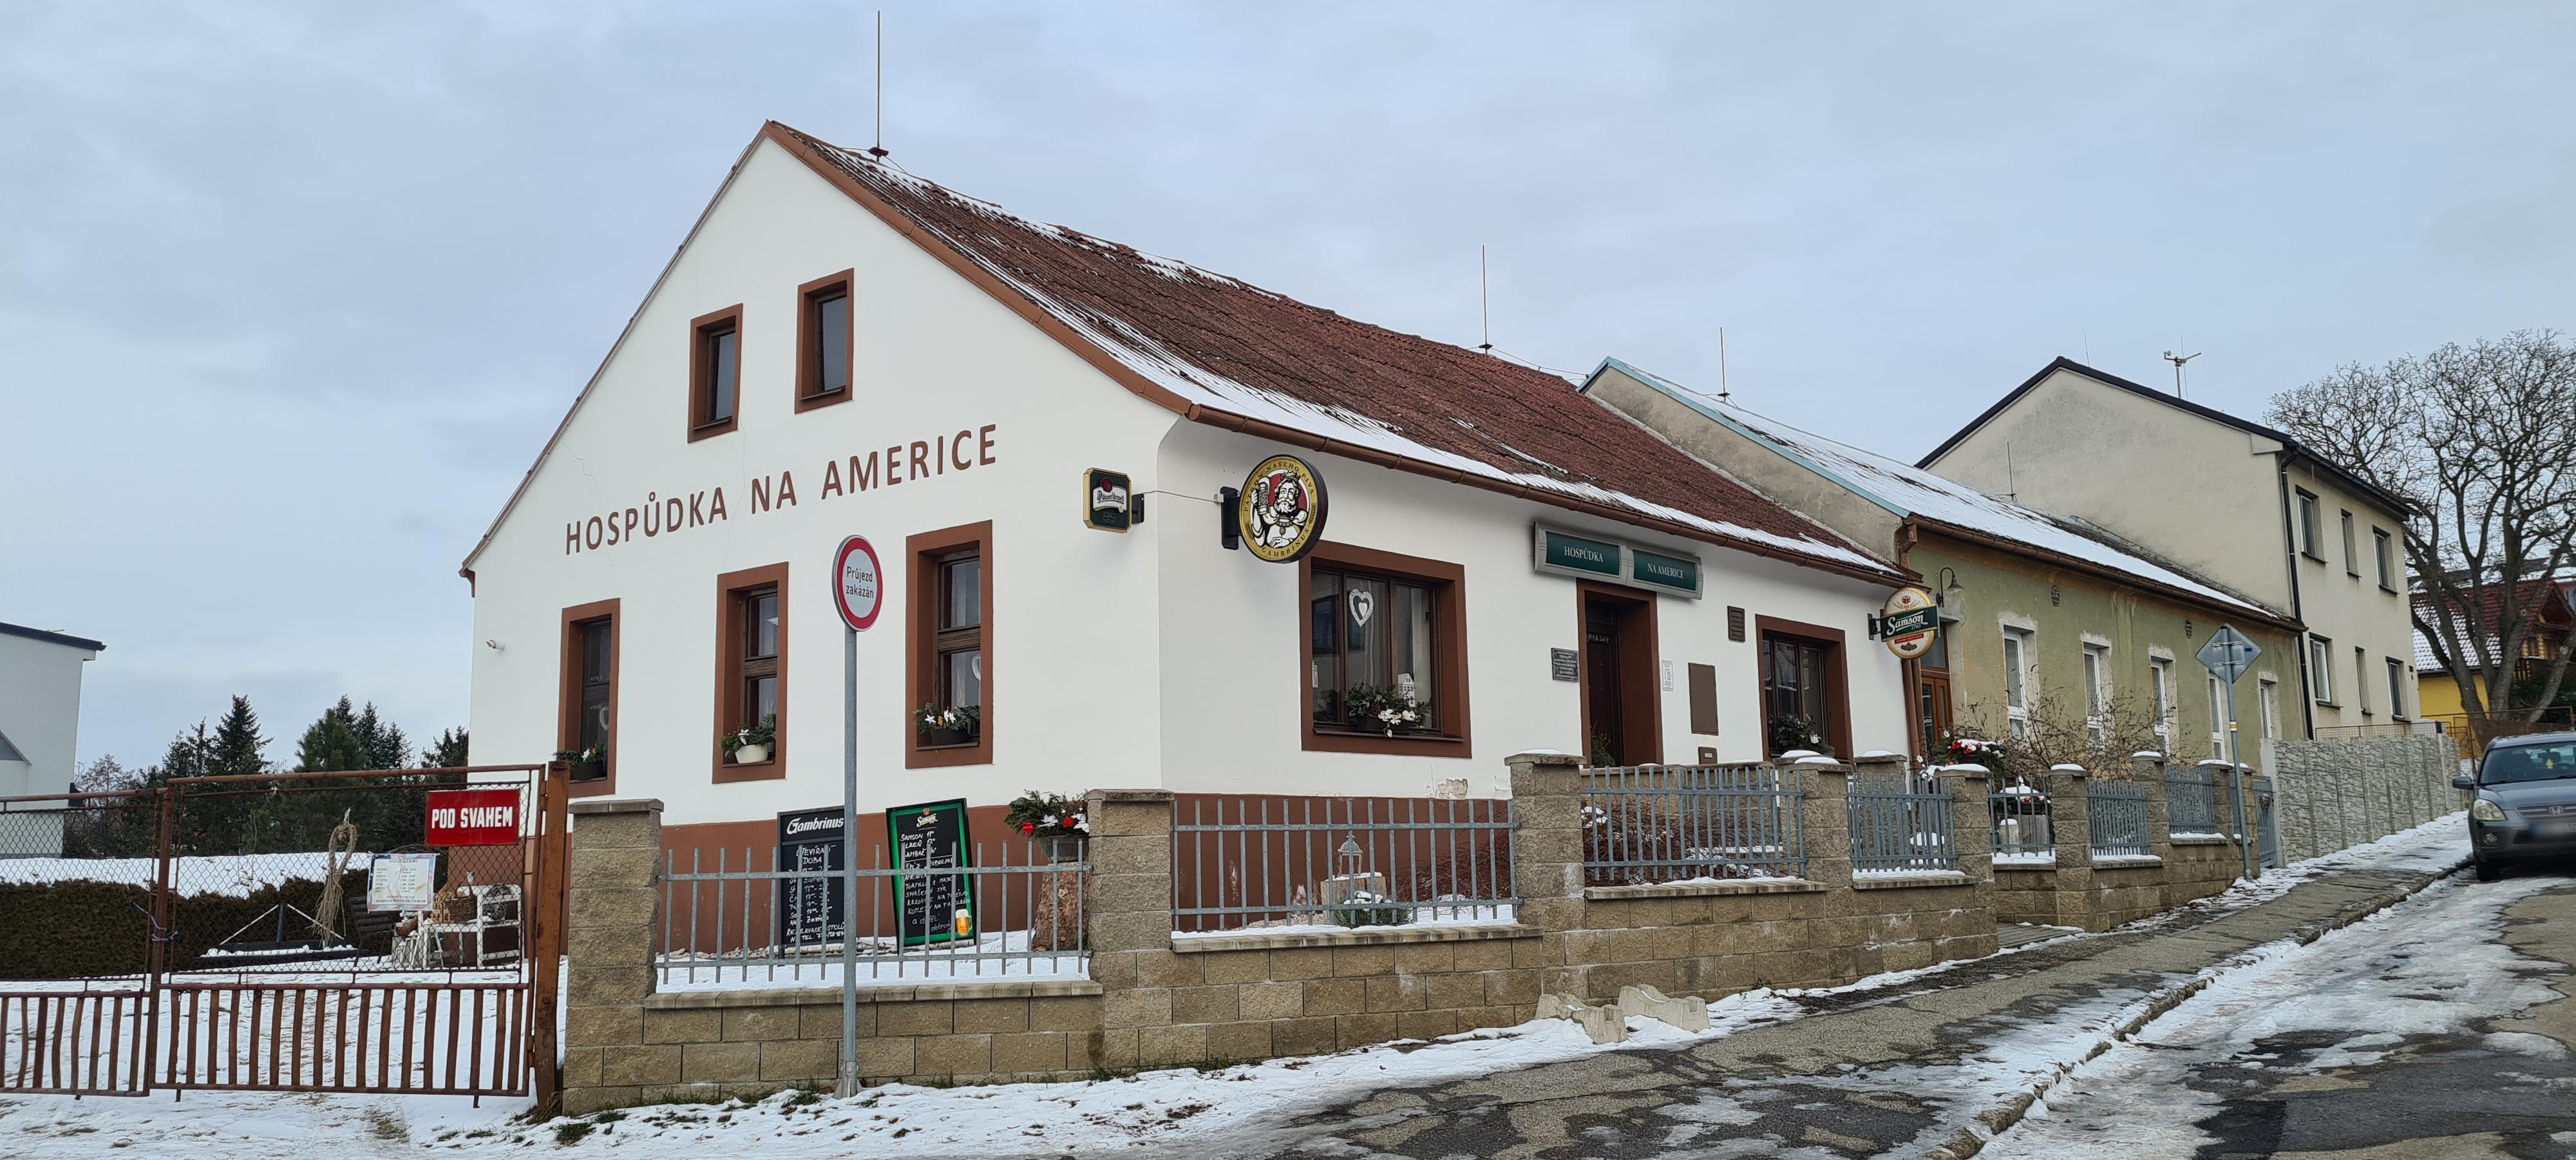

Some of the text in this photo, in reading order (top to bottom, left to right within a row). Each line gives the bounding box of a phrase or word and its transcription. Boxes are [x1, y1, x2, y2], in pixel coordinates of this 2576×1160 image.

[566, 424, 996, 555] HOSPŮDKA NA AMERICE
[1302, 473, 1314, 494] PIVA
[1262, 528, 1309, 557] GAMBRINUS
[1564, 546, 1604, 562] HOSPŮDKA
[847, 566, 873, 584] Průjezd
[1647, 563, 1685, 579] NA AMERICE
[846, 584, 874, 599] zakázán
[1886, 613, 1929, 636] Samson
[431, 806, 513, 829] POD SVAHEM
[786, 817, 844, 835] Gambrinus
[796, 844, 837, 857] TEVÍRAÍ
[905, 839, 922, 849] LZEŇ
[905, 880, 927, 890] TORTILL
[905, 888, 933, 898] SMAŽEÝ
[786, 926, 822, 937] REERVACE
